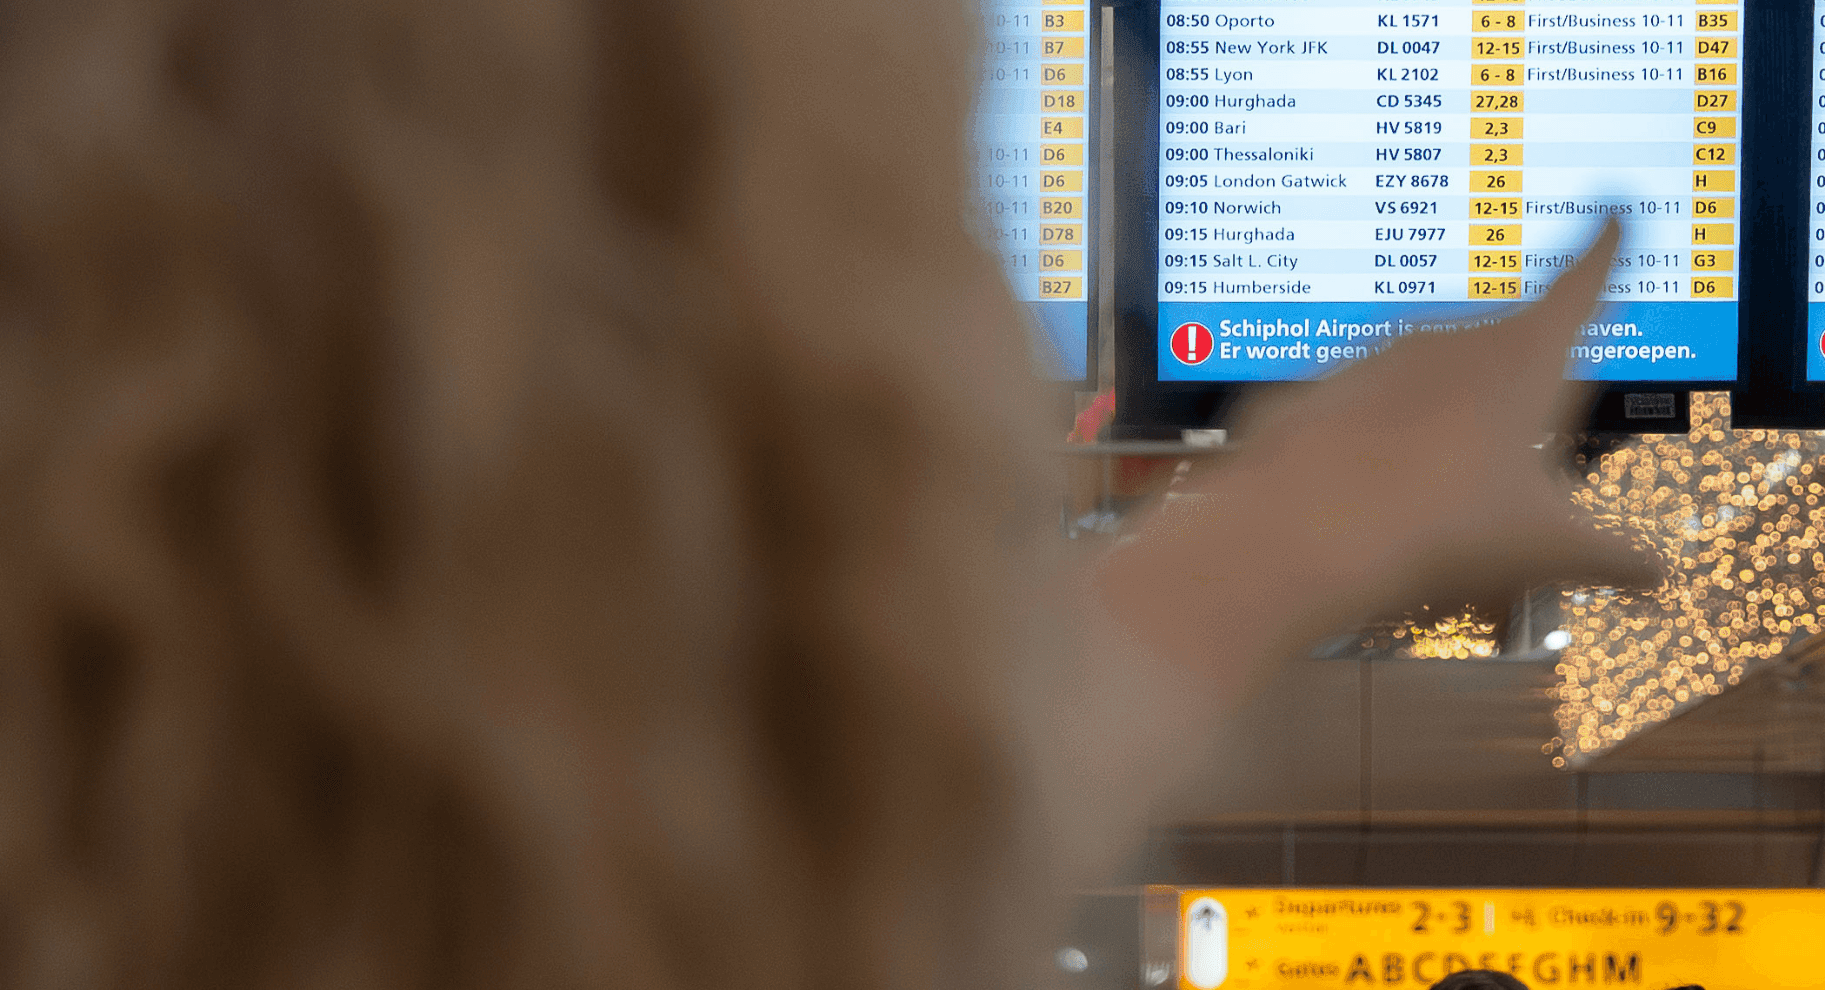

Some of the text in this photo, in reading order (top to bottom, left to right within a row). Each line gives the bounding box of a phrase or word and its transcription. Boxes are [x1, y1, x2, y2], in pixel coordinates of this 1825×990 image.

[1165, 146, 1726, 164] 09:00 Thessaloniki HV 5807 2,3 C12
[1219, 318, 1310, 341] Schiphol
[1315, 318, 1391, 341] Airport
[1220, 340, 1367, 364] Er wordt geen
